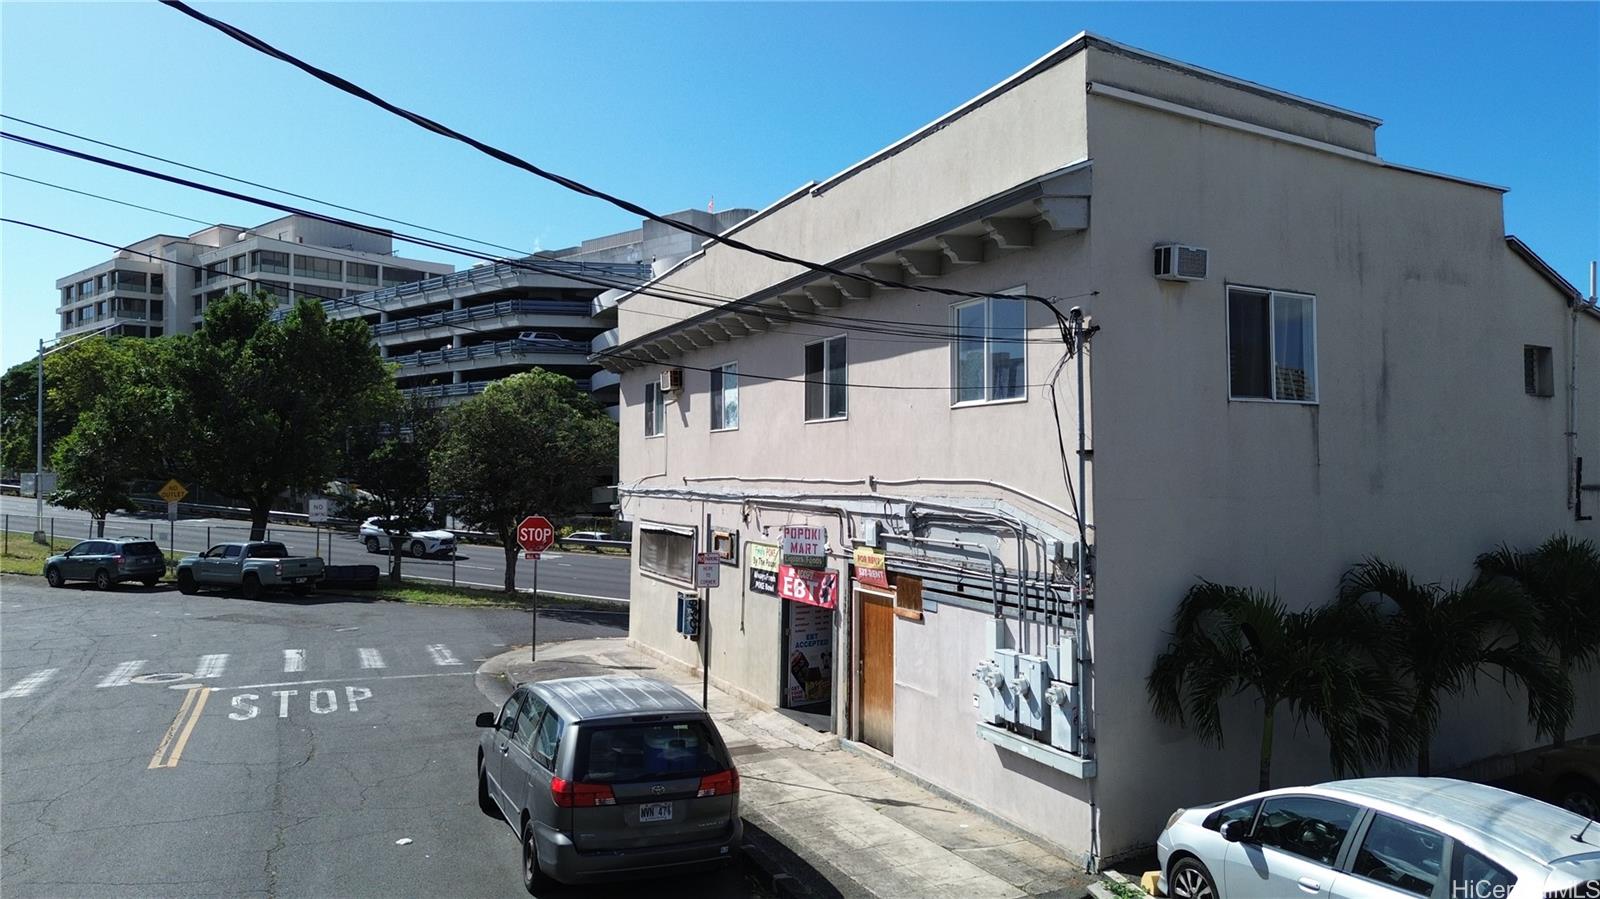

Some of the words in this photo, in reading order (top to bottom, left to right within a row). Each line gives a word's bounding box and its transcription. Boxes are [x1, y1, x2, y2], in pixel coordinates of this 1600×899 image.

[520, 528, 551, 542] STOP
[784, 528, 821, 540] POPOKI
[790, 543, 818, 554] MART
[783, 576, 819, 601] EBT
[795, 640, 828, 649] ACCEPTED
[228, 686, 373, 720] STOP
